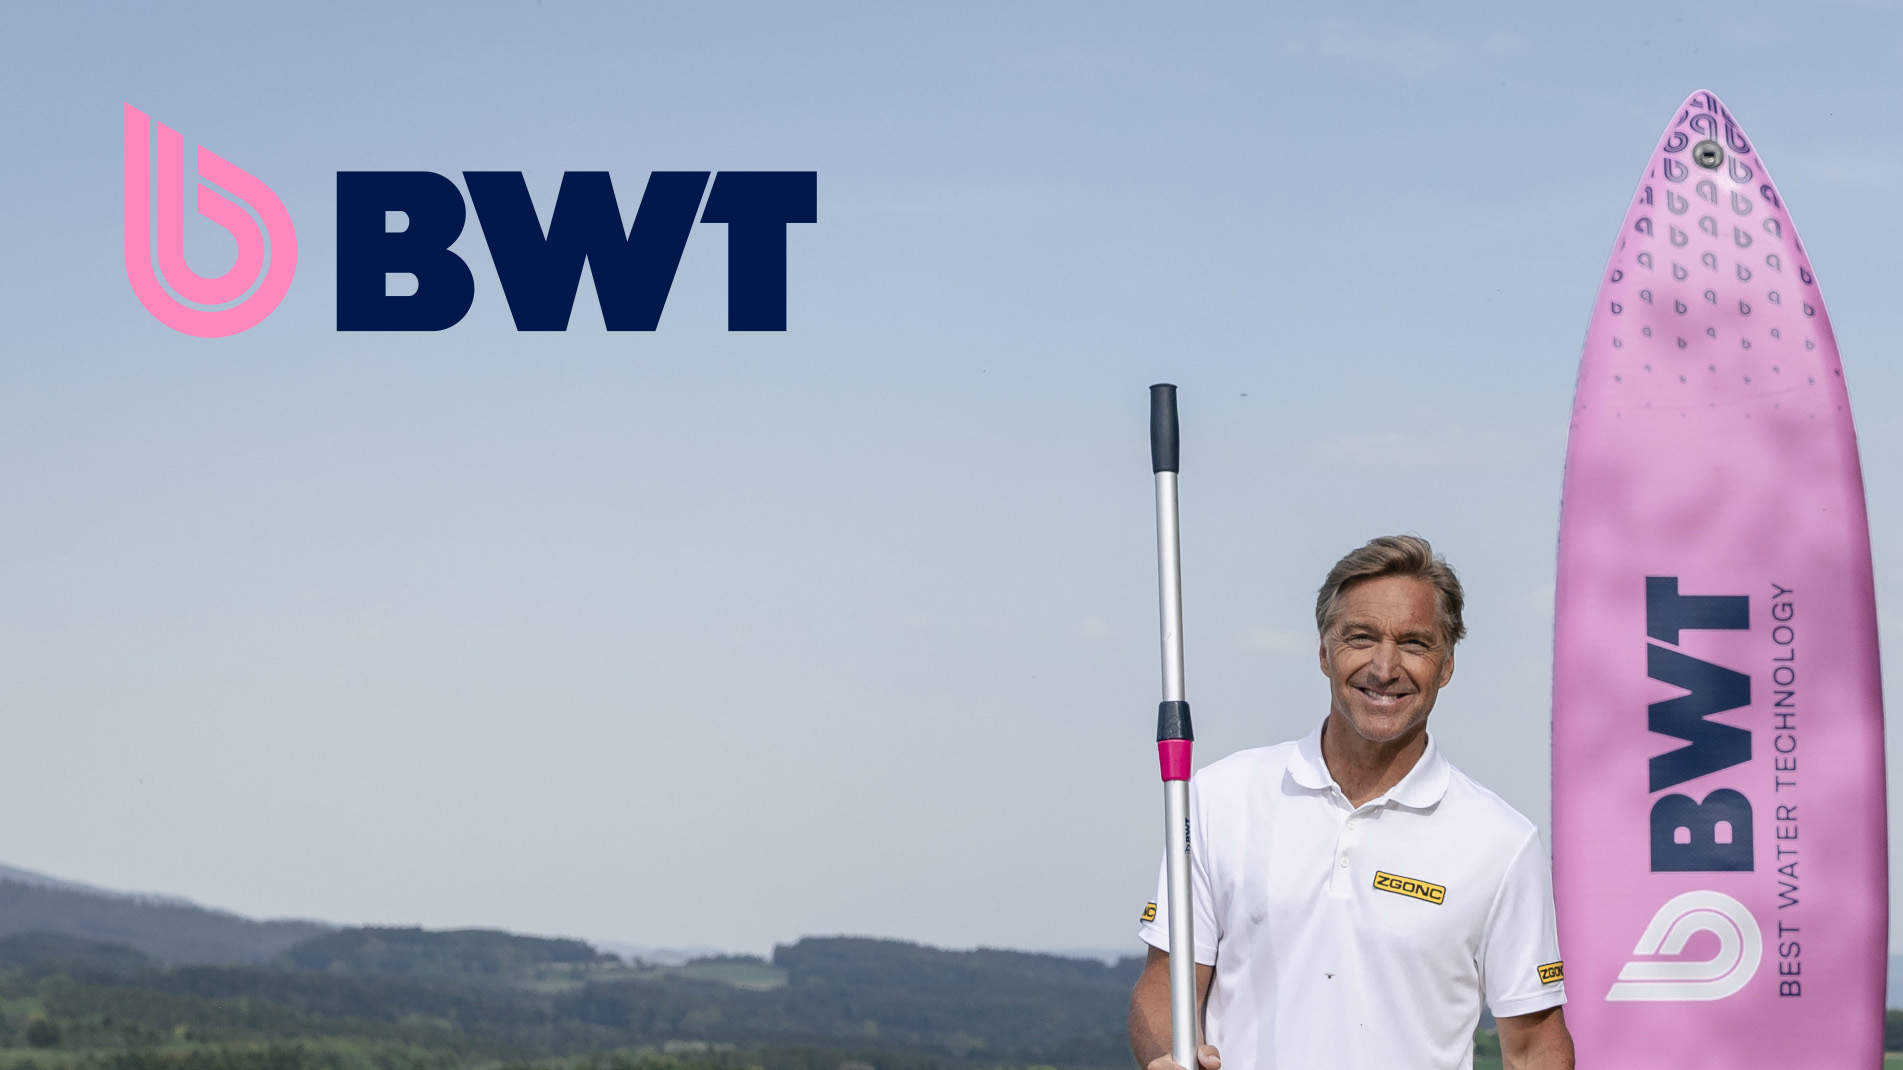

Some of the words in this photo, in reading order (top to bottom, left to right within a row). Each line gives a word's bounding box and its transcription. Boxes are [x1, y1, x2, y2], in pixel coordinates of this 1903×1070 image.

[1645, 576, 1754, 873] BWT
[1772, 582, 1797, 792] TECHNOLOGY
[1377, 874, 1442, 900] ZGONC
[1776, 804, 1798, 910] WATER
[1778, 921, 1801, 997] BEST
